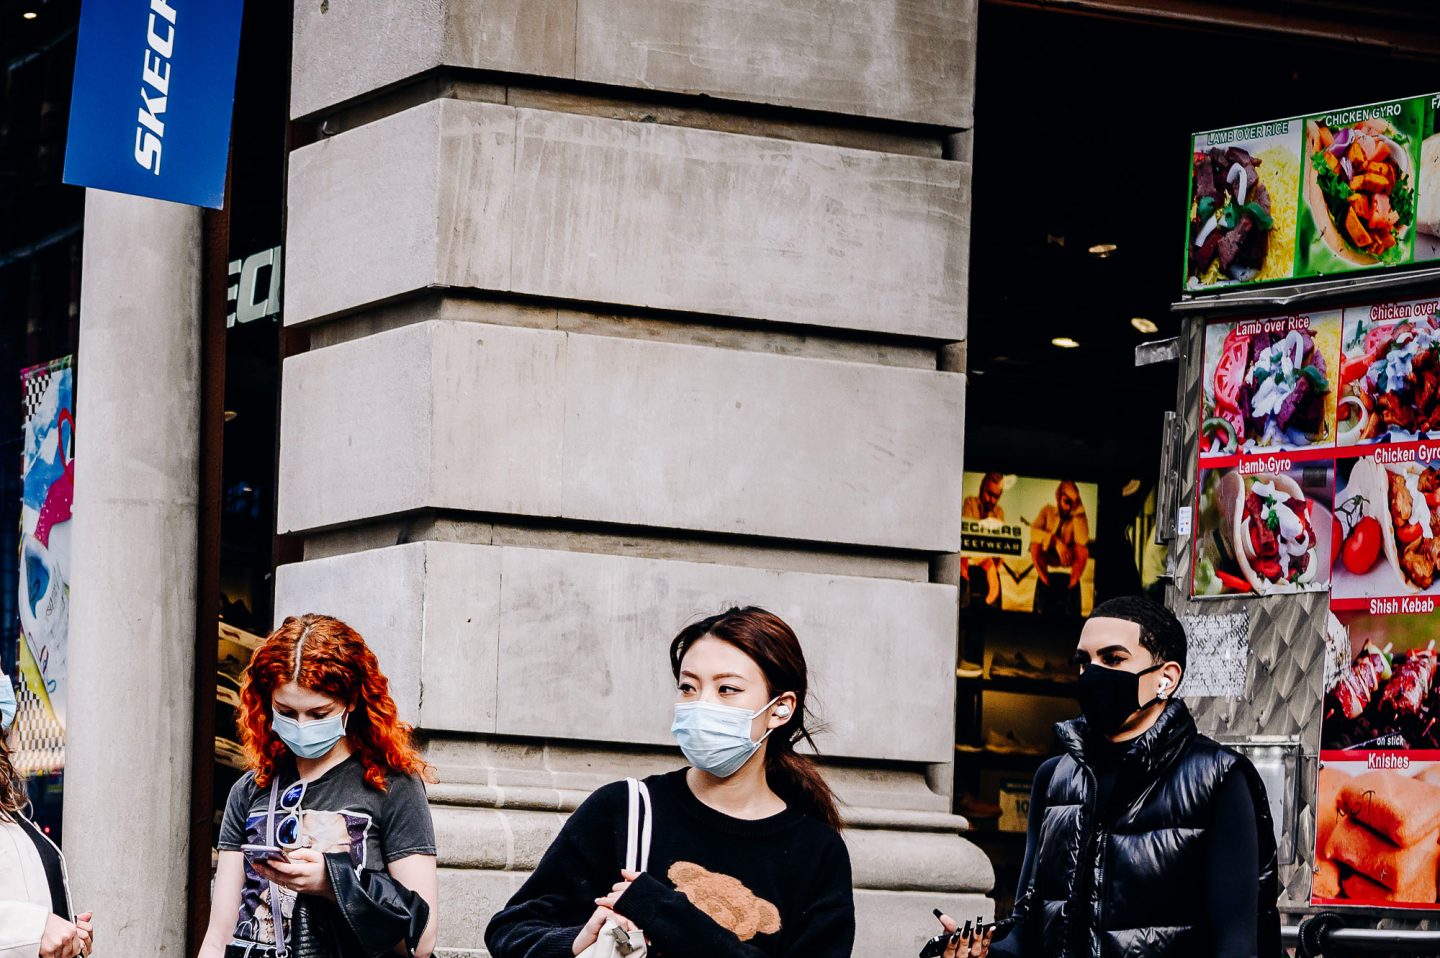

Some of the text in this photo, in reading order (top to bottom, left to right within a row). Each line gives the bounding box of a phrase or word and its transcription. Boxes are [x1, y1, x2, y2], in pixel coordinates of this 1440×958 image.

[1325, 104, 1401, 126] CHICKEN GYRO
[1207, 122, 1289, 145] LAMB OVER RICE
[1370, 302, 1439, 321] Chicken over
[1235, 316, 1309, 336] Lamb over Rice
[1374, 447, 1415, 464] Chicken
[1238, 456, 1291, 475] Lamb Gyro
[1369, 597, 1434, 614] Shish Kebab
[1376, 735, 1404, 746] on stick
[1367, 752, 1410, 769] Knishes
